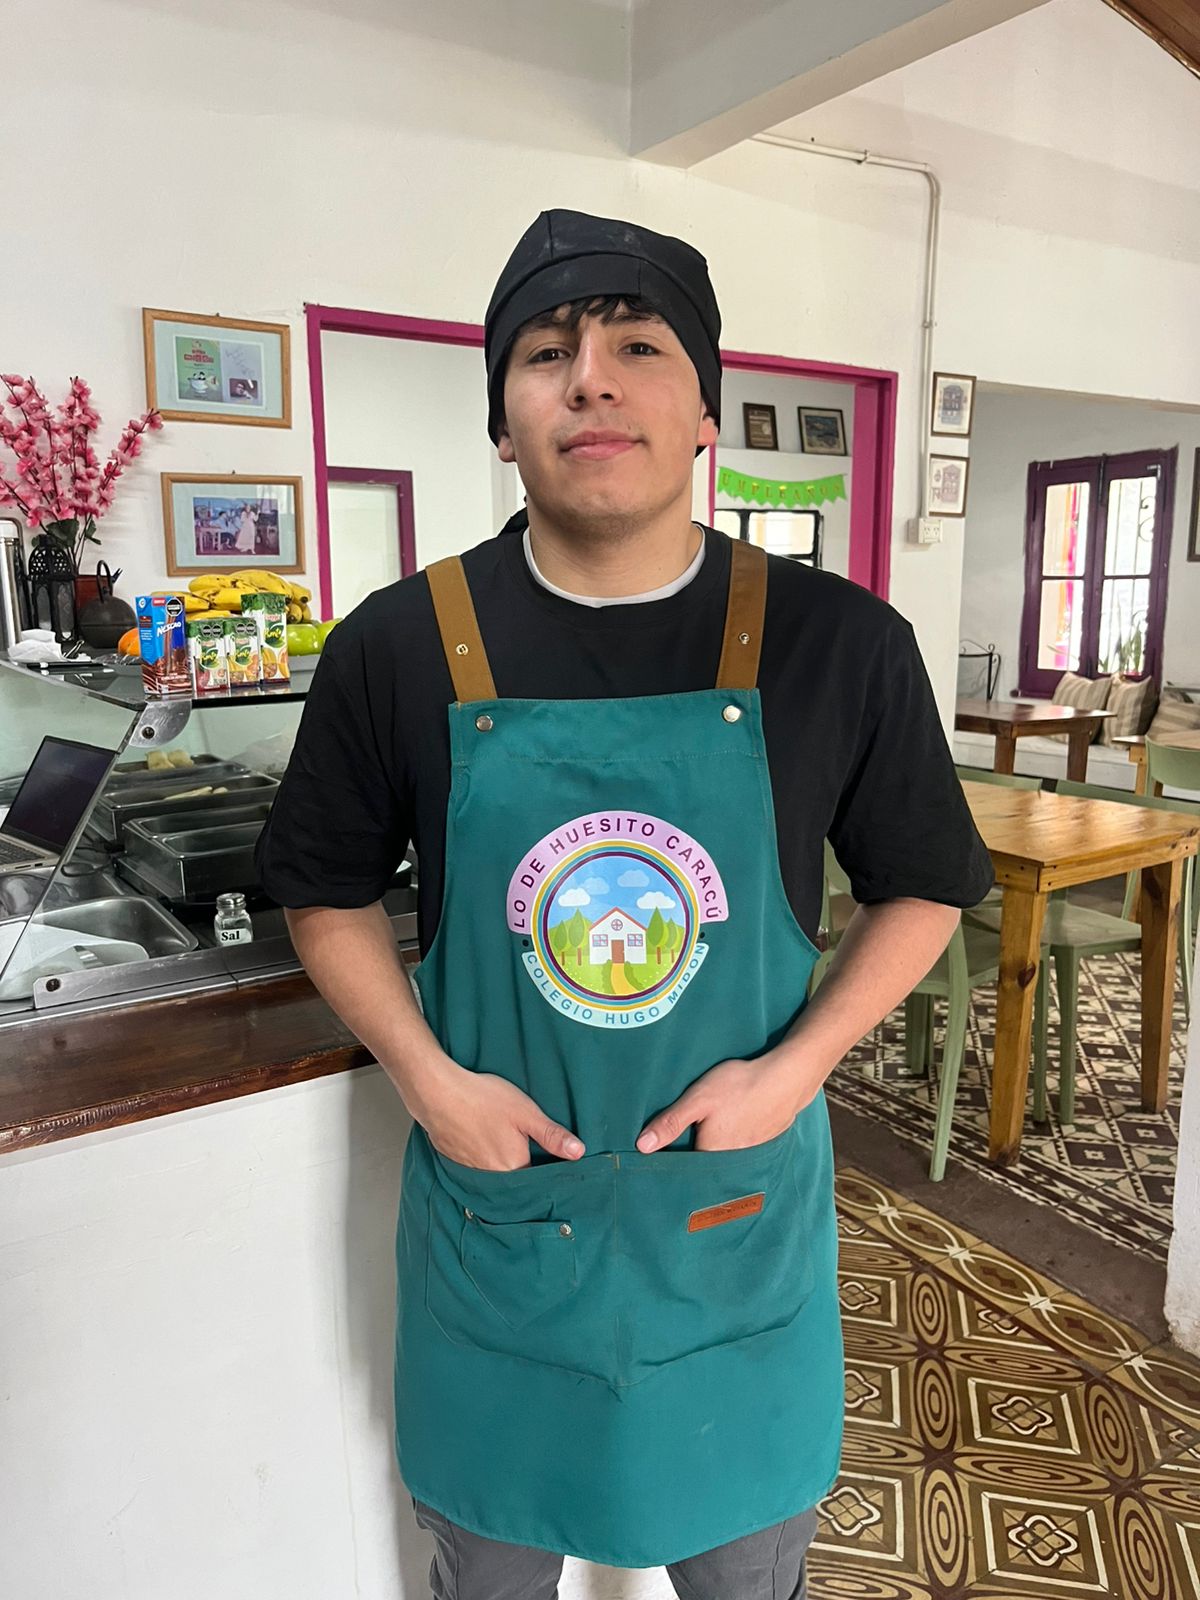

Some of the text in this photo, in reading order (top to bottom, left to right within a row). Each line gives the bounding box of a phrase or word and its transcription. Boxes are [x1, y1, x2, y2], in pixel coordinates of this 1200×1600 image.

[514, 818, 722, 928] LO DE HUESITO CARACÚ
[221, 930, 240, 941] Sal
[527, 945, 705, 1024] COLEGIO HUGO MIDON
